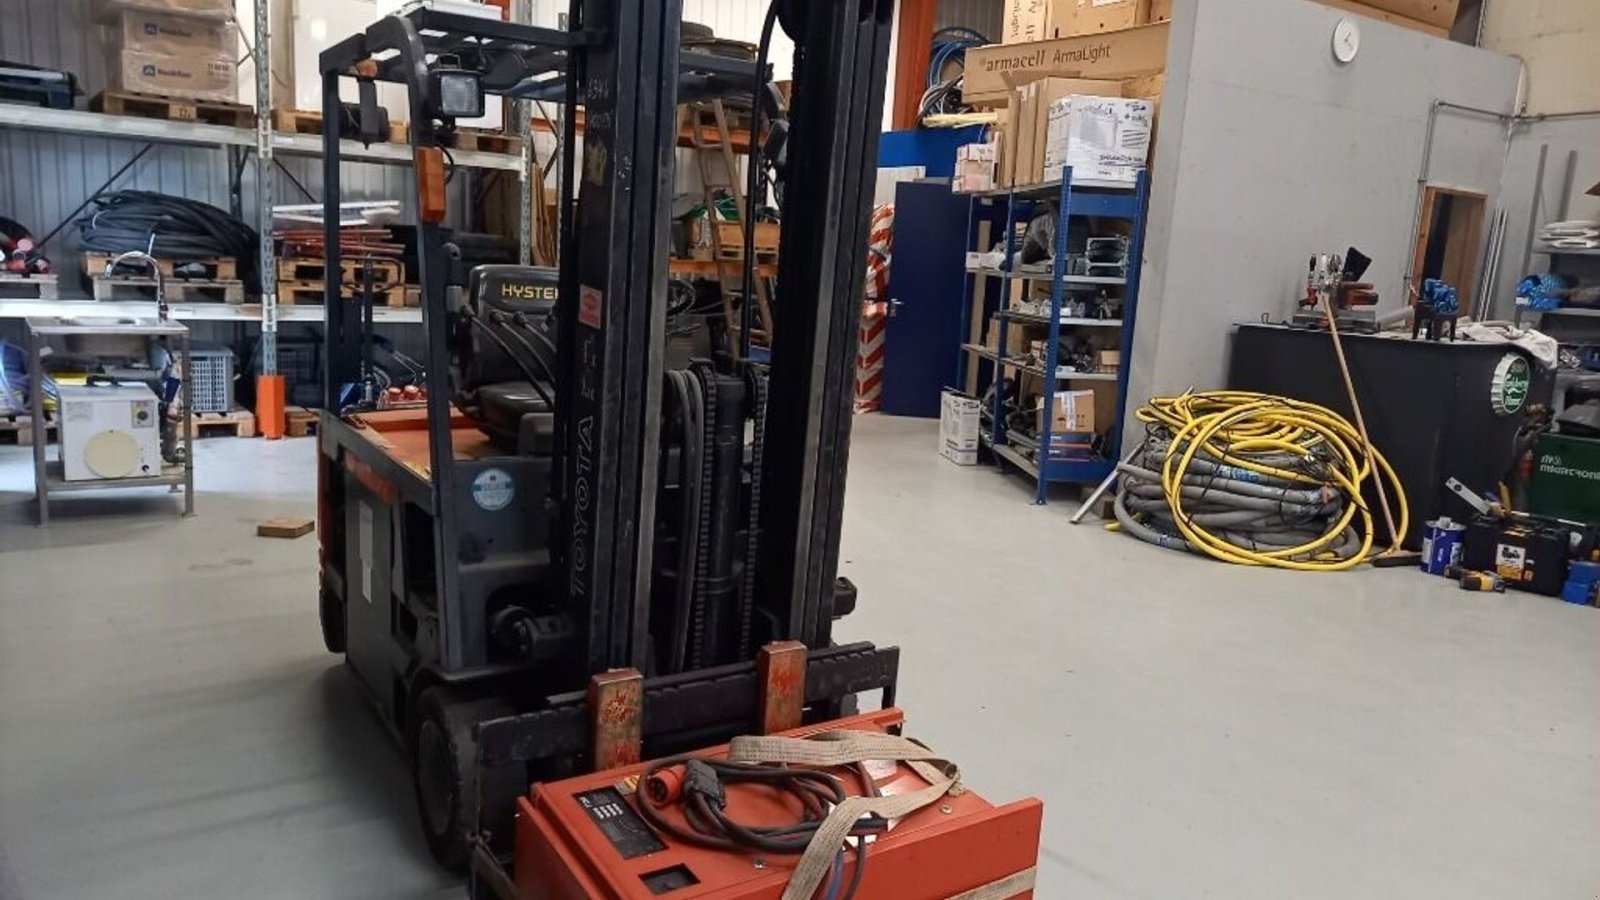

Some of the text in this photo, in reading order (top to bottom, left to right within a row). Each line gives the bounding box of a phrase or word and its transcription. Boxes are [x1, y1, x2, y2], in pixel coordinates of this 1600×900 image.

[986, 44, 1112, 72] armacell ArmaLight
[570, 414, 594, 597] TOYOTA
